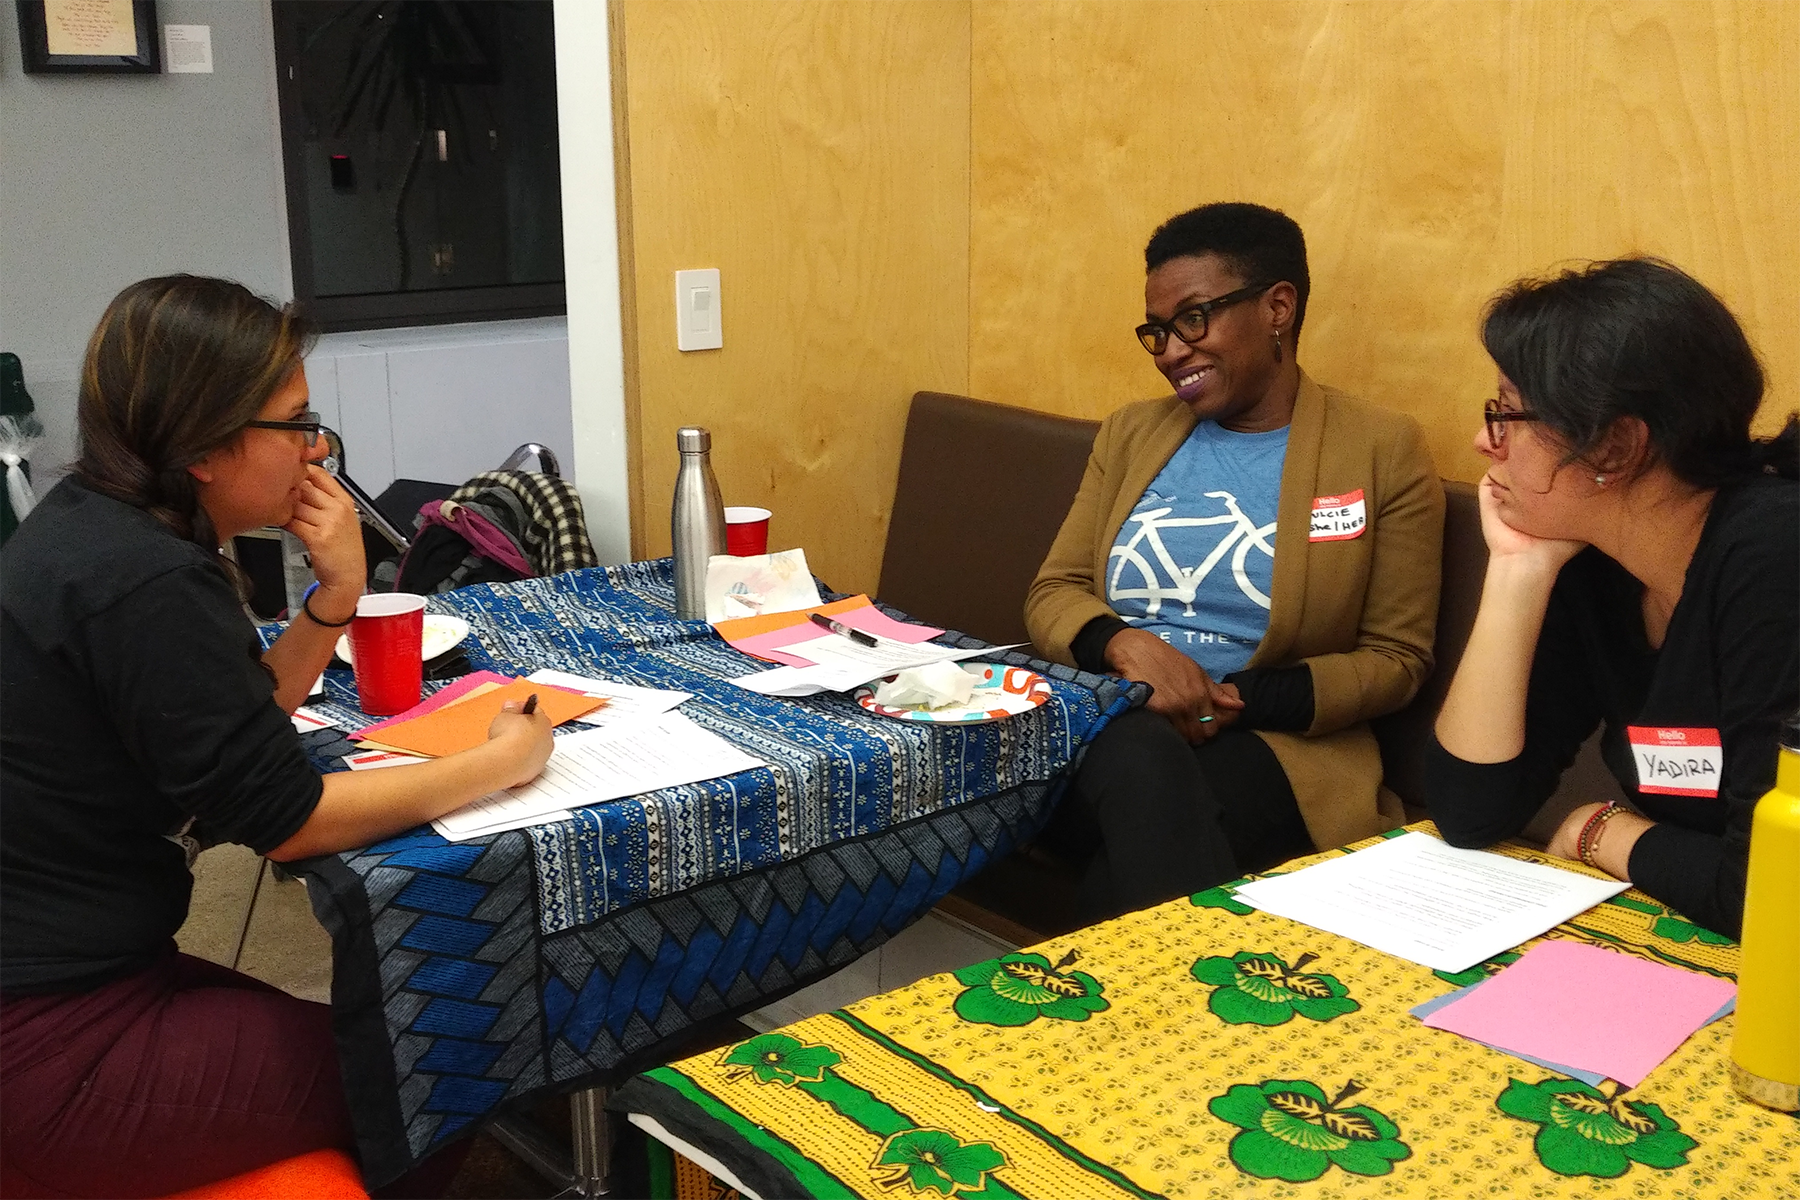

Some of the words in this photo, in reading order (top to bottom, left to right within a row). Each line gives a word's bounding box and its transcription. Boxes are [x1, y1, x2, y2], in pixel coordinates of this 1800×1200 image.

[1311, 508, 1350, 518] ULCIE
[1183, 631, 1230, 644] THE
[1657, 730, 1686, 740] Hello
[1642, 753, 1715, 779] YADIRA
